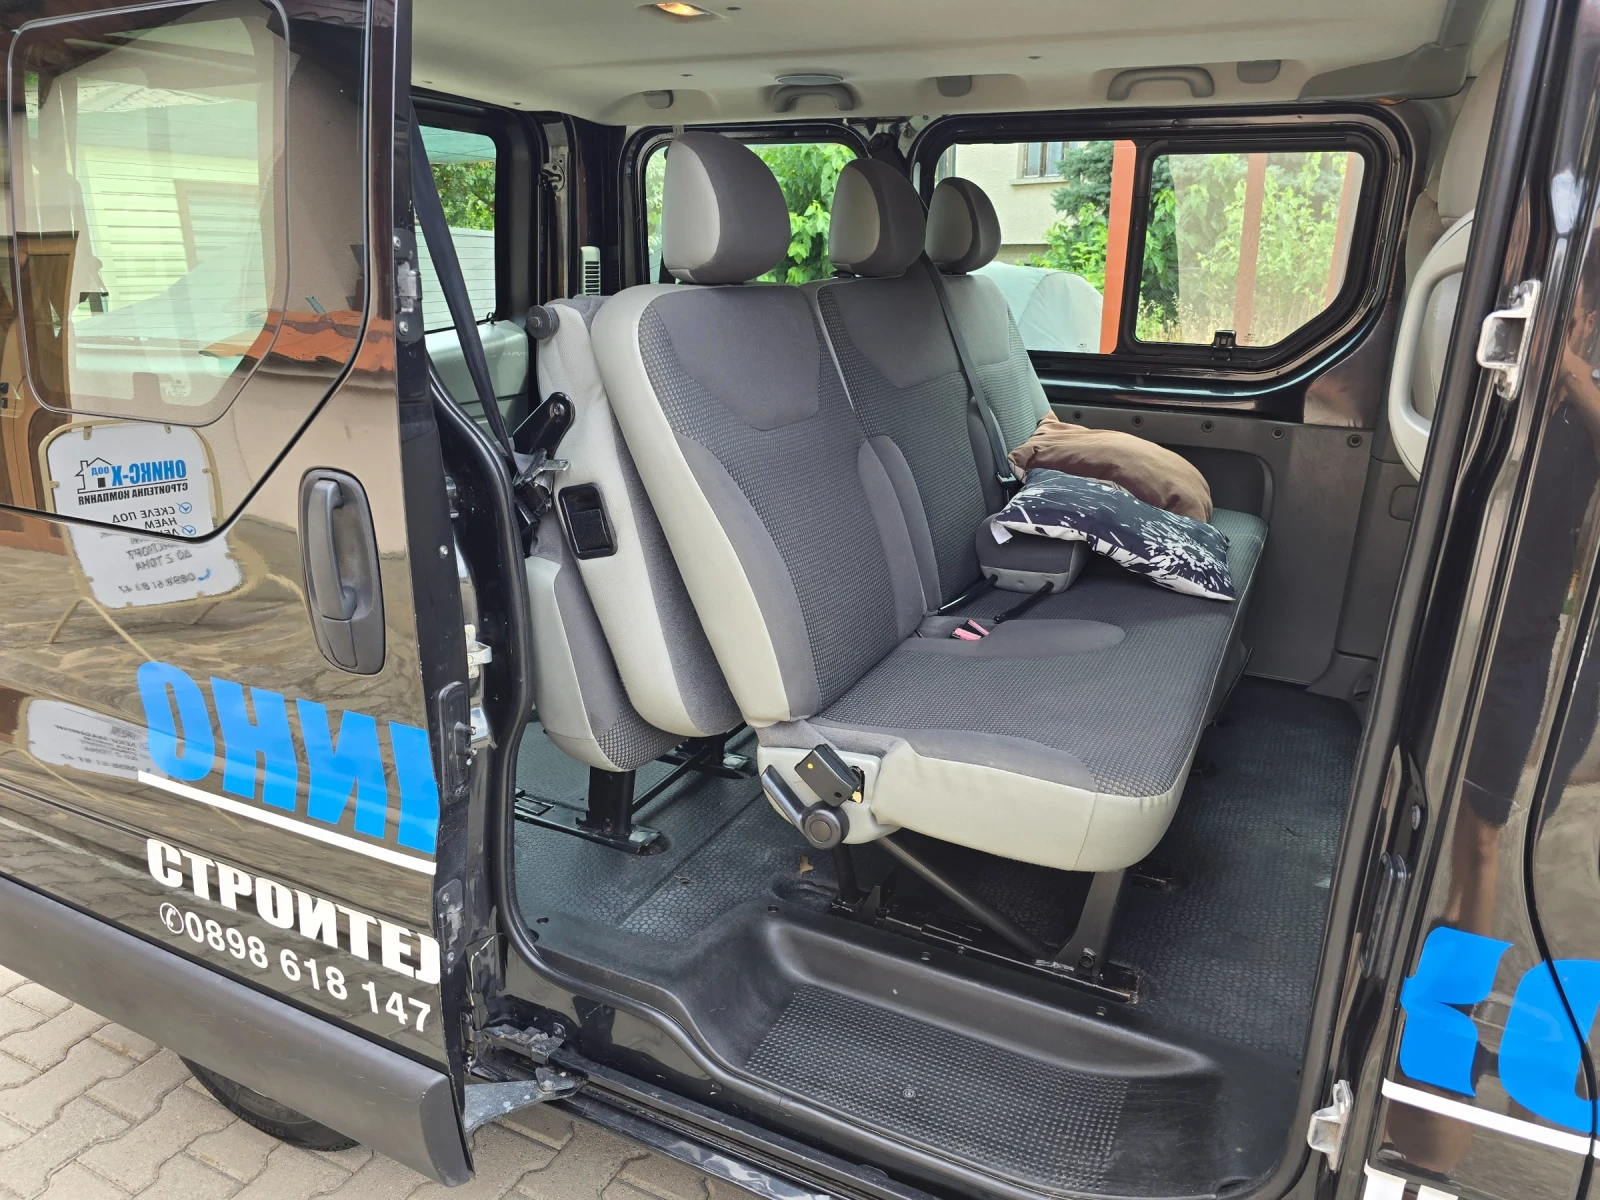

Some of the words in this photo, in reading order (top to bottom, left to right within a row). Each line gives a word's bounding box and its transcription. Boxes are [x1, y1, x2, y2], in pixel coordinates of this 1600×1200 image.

[183, 912, 269, 970] 0898
[279, 948, 349, 1001] 618
[361, 980, 432, 1033] 147
